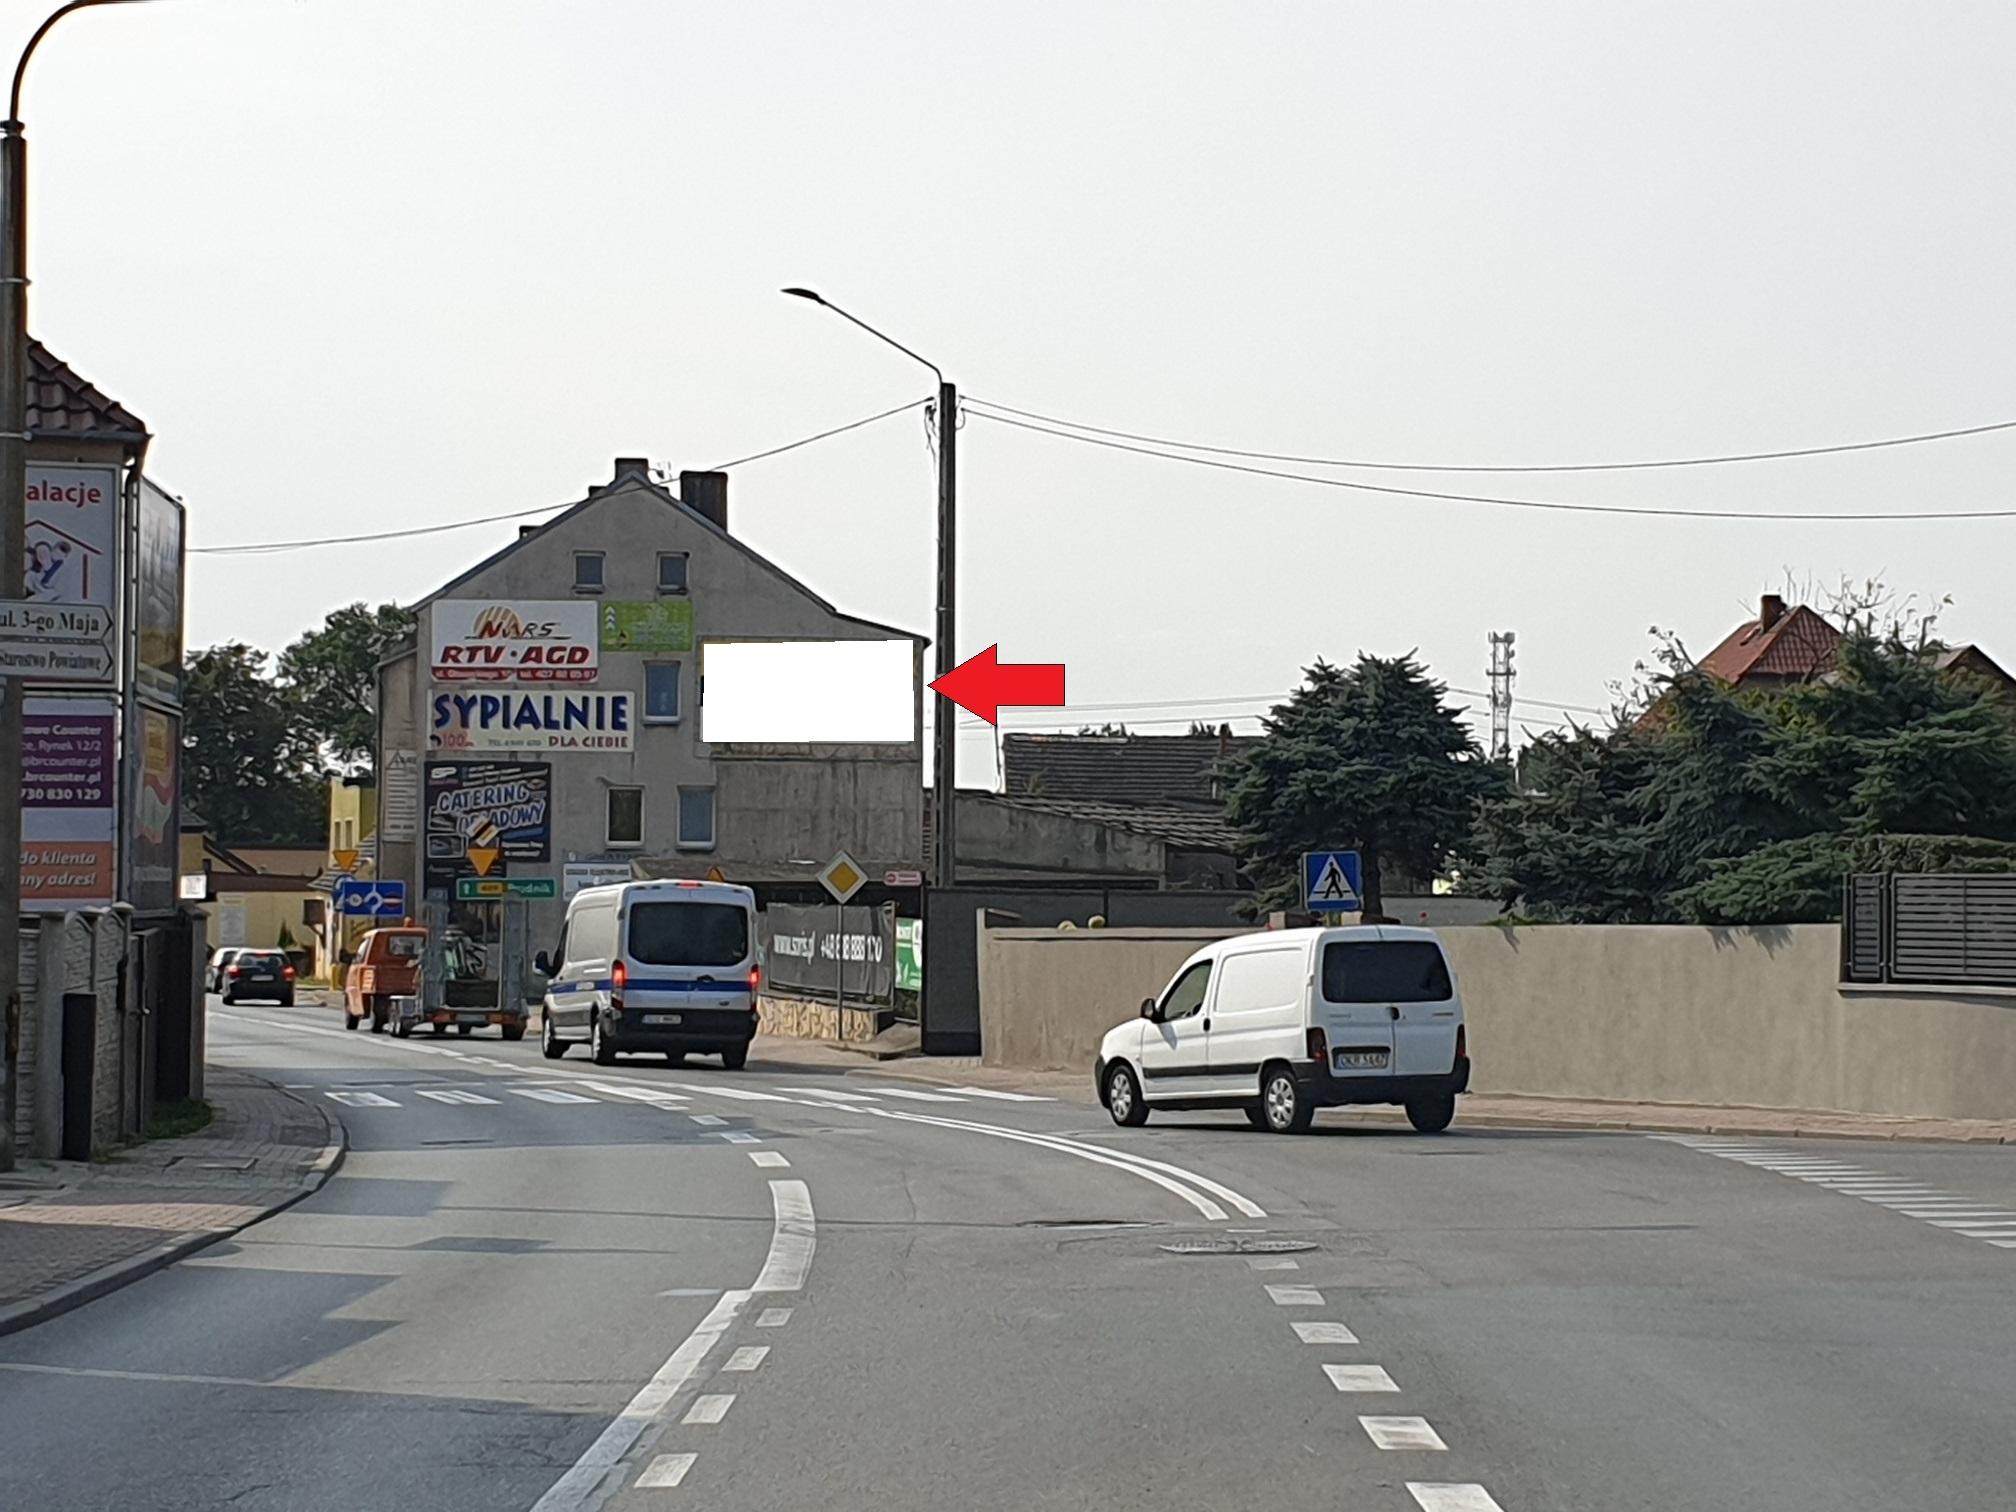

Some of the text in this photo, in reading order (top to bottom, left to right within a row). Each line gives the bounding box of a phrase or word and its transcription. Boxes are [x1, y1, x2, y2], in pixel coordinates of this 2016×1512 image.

[26, 480, 101, 508] alacje
[21, 611, 54, 632] 3-go
[60, 612, 99, 635] Maja
[440, 646, 590, 664] RTV AGD
[434, 693, 628, 731] SYPIALNIE
[52, 724, 102, 735] Counter
[38, 739, 73, 752] Rynek
[76, 740, 102, 751] 12/2
[549, 735, 580, 748] DLA
[582, 735, 628, 748] CIEBIE
[47, 788, 73, 800] 830
[76, 788, 102, 800] 129
[438, 782, 529, 813] CATERING
[41, 850, 97, 865] klienta
[46, 871, 97, 886] adres!
